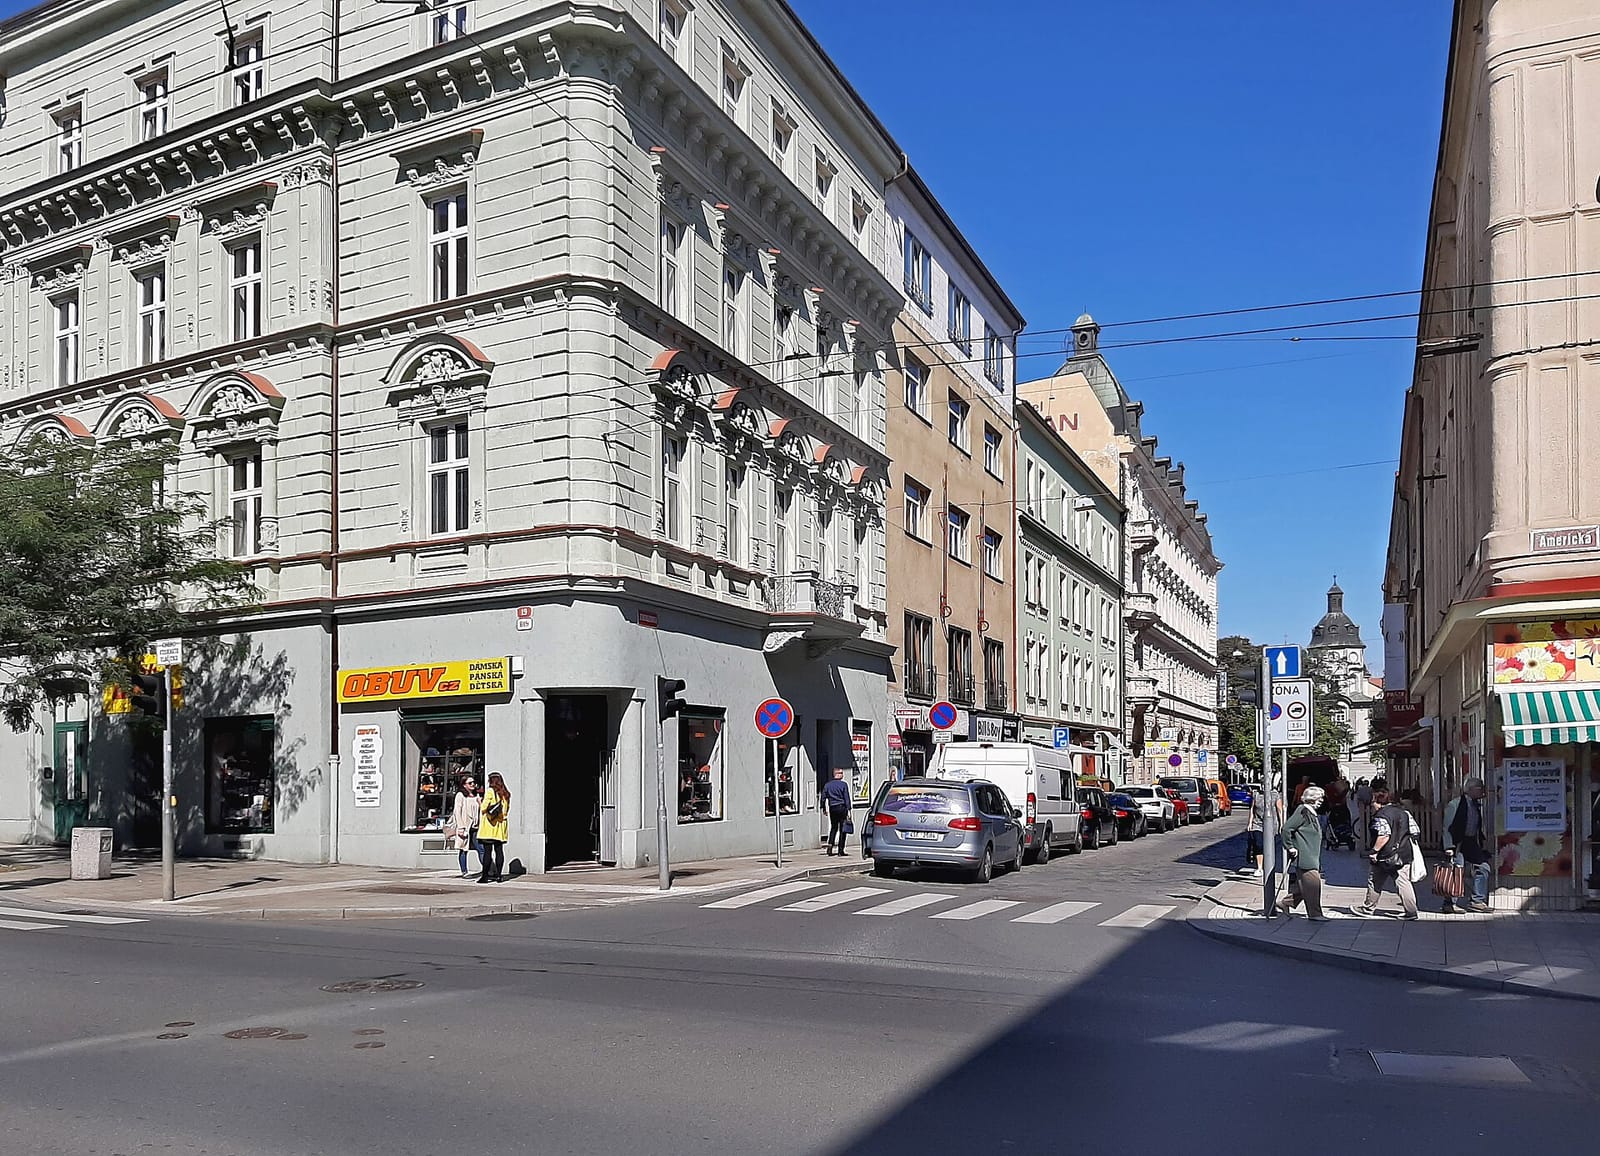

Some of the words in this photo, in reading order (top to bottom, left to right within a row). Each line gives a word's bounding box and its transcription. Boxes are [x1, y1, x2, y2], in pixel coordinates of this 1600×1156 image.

[1540, 531, 1592, 547] Americká
[469, 661, 503, 671] DÁMSKÁ
[469, 671, 503, 681] PÁNSKÁ
[342, 667, 447, 698] OBUV
[1392, 704, 1416, 712] SLEVA
